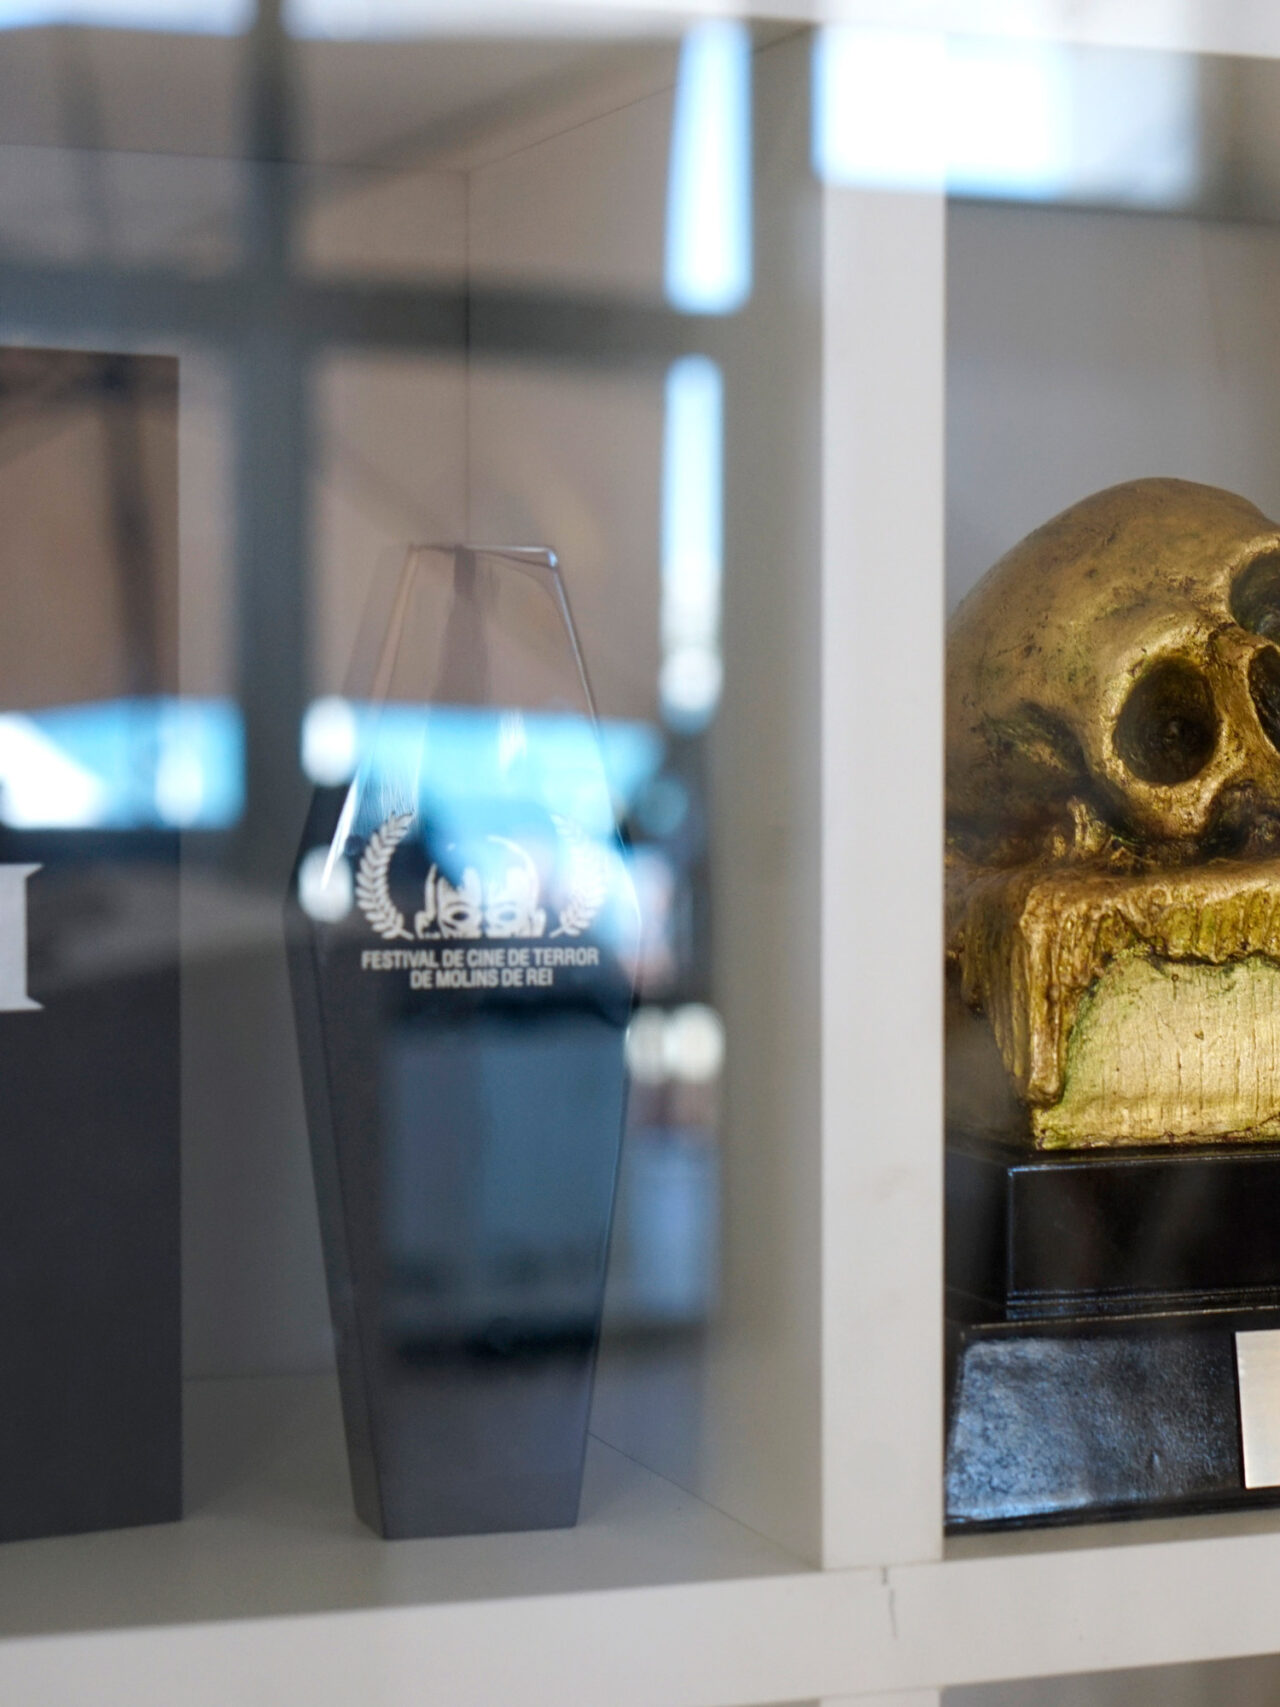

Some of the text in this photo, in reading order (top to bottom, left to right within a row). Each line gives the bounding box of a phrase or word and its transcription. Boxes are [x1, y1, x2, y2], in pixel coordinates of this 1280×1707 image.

[361, 946, 599, 971] FESTIVAL DE CINE DE TERROR
[409, 967, 553, 989] DE MOLINS DE REI
